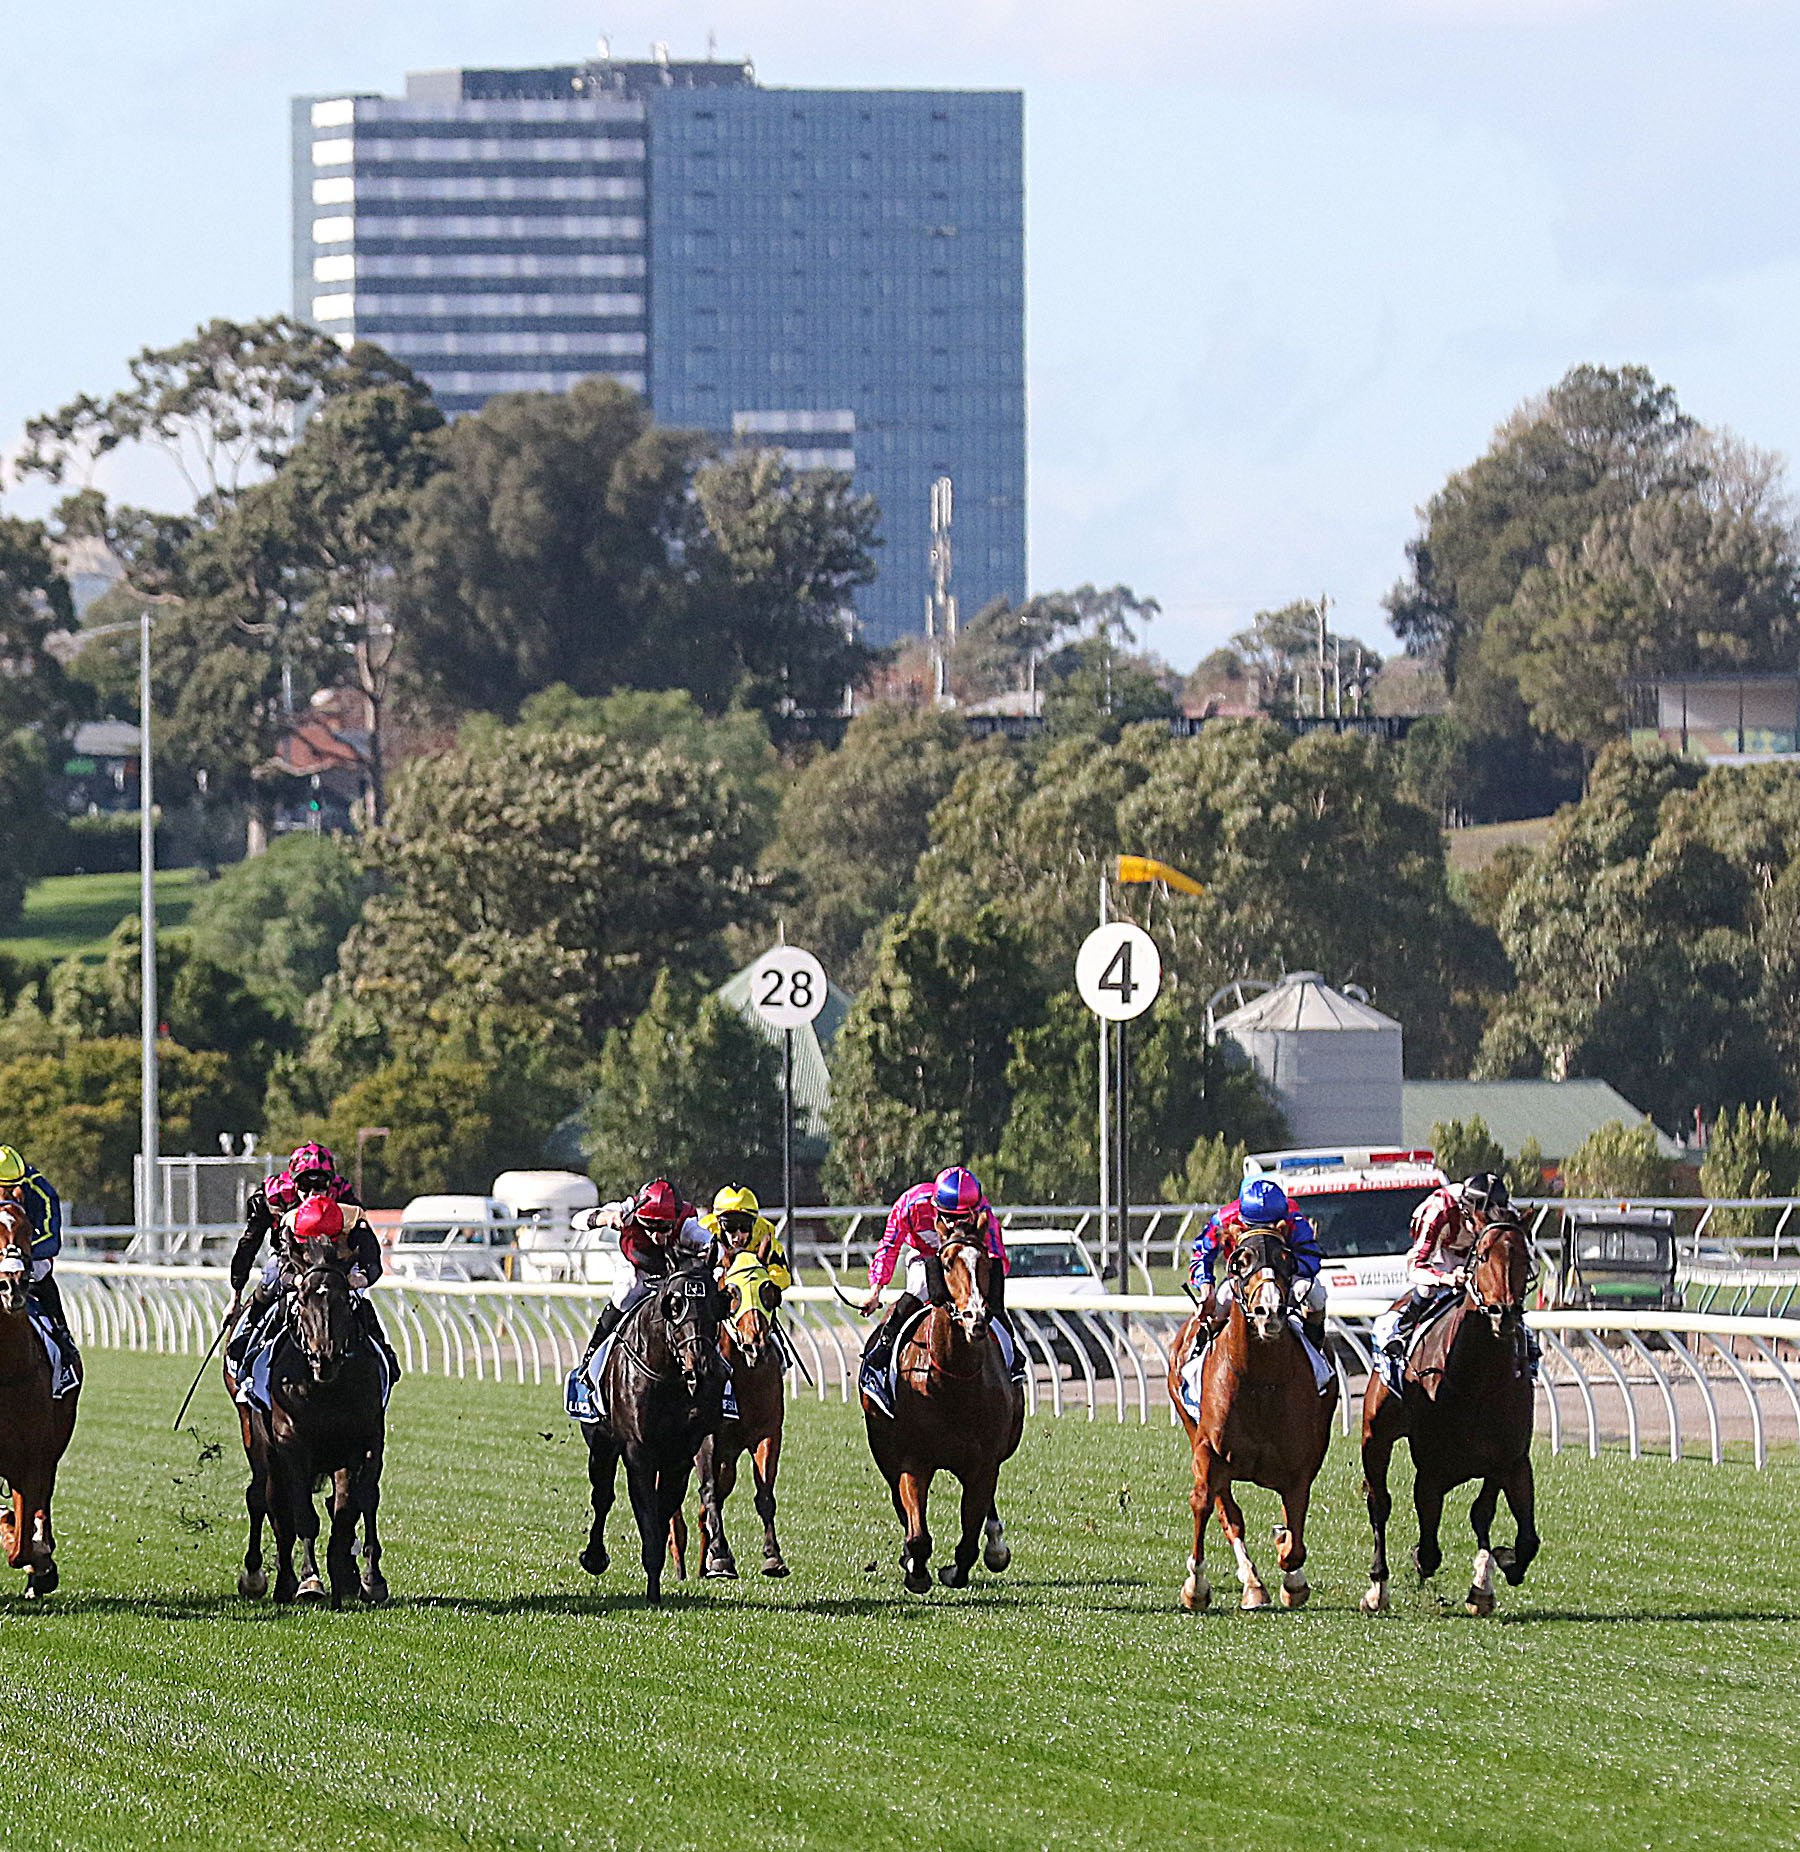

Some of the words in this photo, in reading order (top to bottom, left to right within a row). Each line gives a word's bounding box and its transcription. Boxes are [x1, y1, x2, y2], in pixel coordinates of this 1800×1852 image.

[759, 969, 813, 1008] 28
[1098, 941, 1139, 1004] 4
[1293, 1182, 1349, 1195] PATIENT
[1356, 1178, 1435, 1191] TRANSPORT
